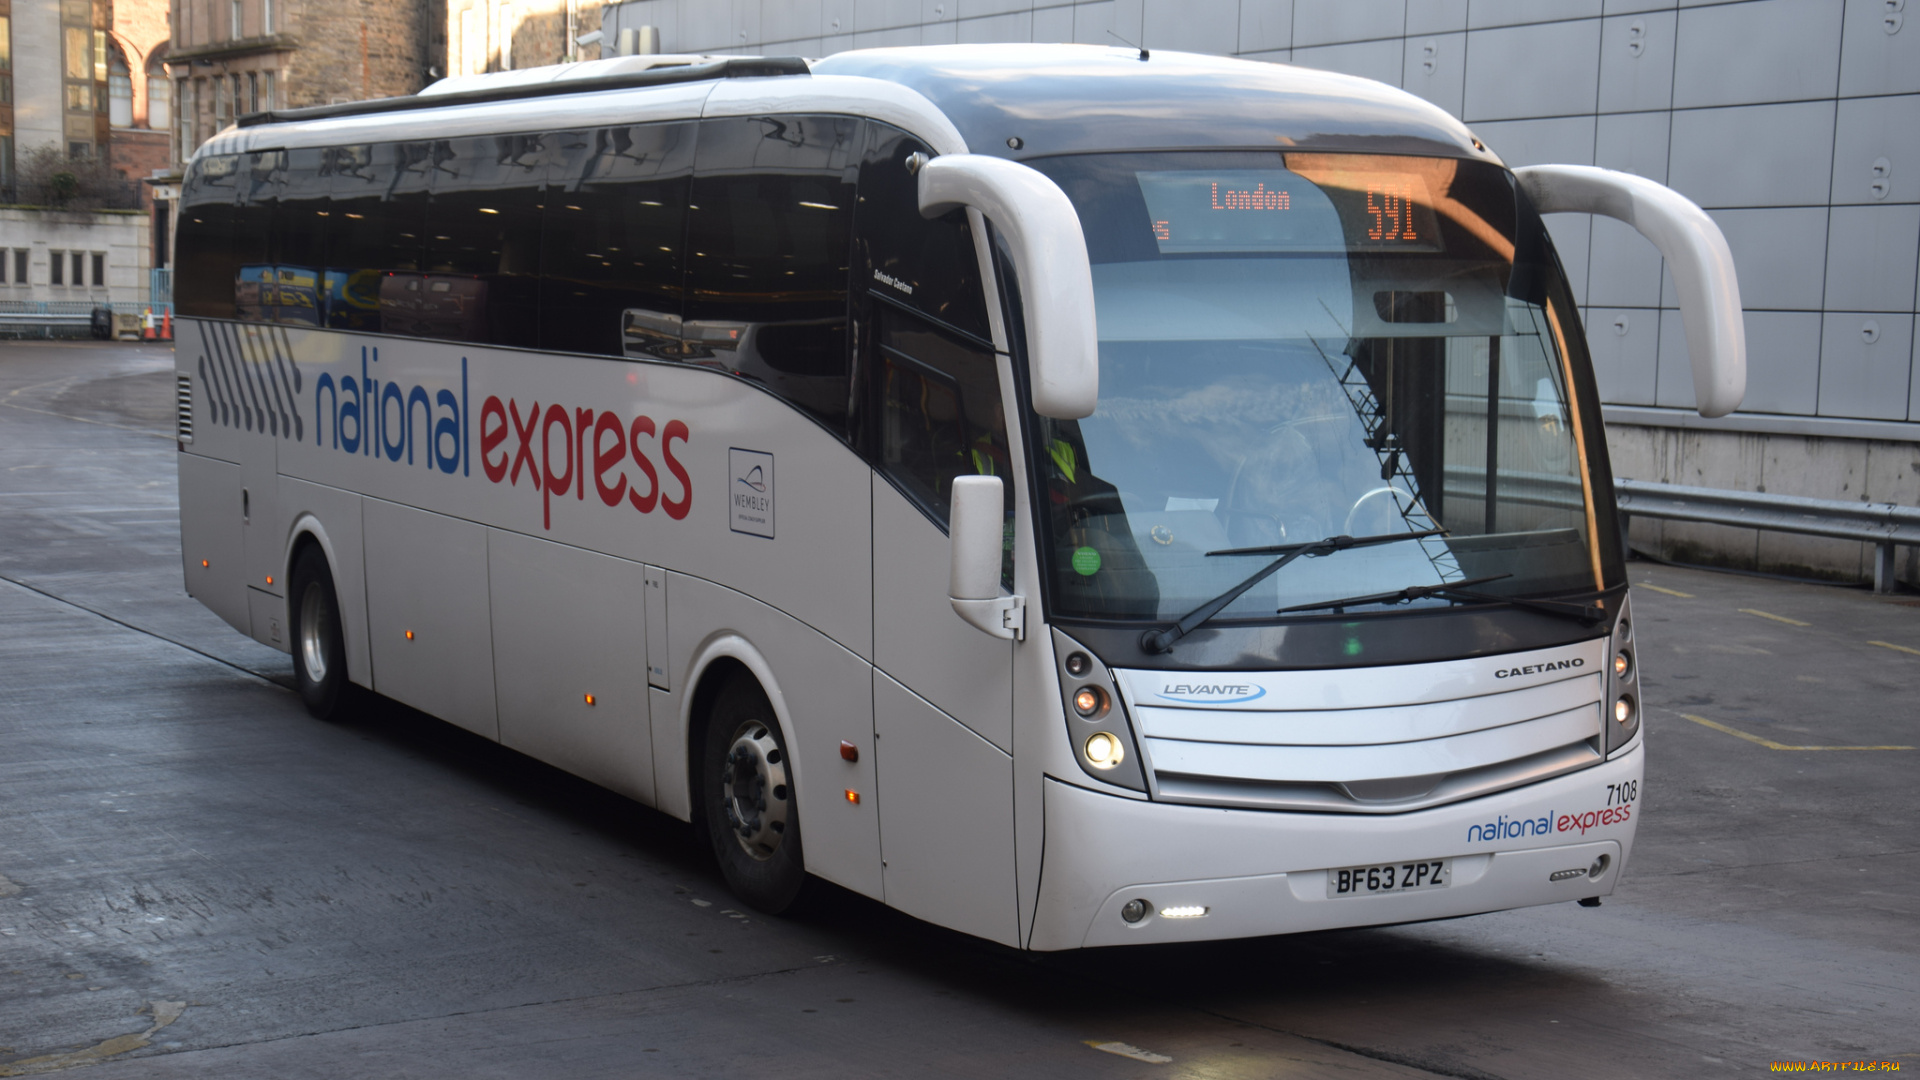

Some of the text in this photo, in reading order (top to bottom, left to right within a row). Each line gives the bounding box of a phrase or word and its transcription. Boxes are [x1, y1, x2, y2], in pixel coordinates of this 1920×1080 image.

[1212, 182, 1290, 210] London
[1367, 183, 1417, 240] 591
[874, 268, 912, 294] Salvador Caetano
[315, 345, 693, 531] national express
[733, 492, 770, 512] WEMBLEY
[1494, 657, 1585, 679] CAETANO
[1163, 684, 1250, 695] LEVANTE
[1606, 779, 1638, 806] 7108
[1467, 804, 1632, 843] national express
[1337, 861, 1444, 893] BF63 ZPZ
